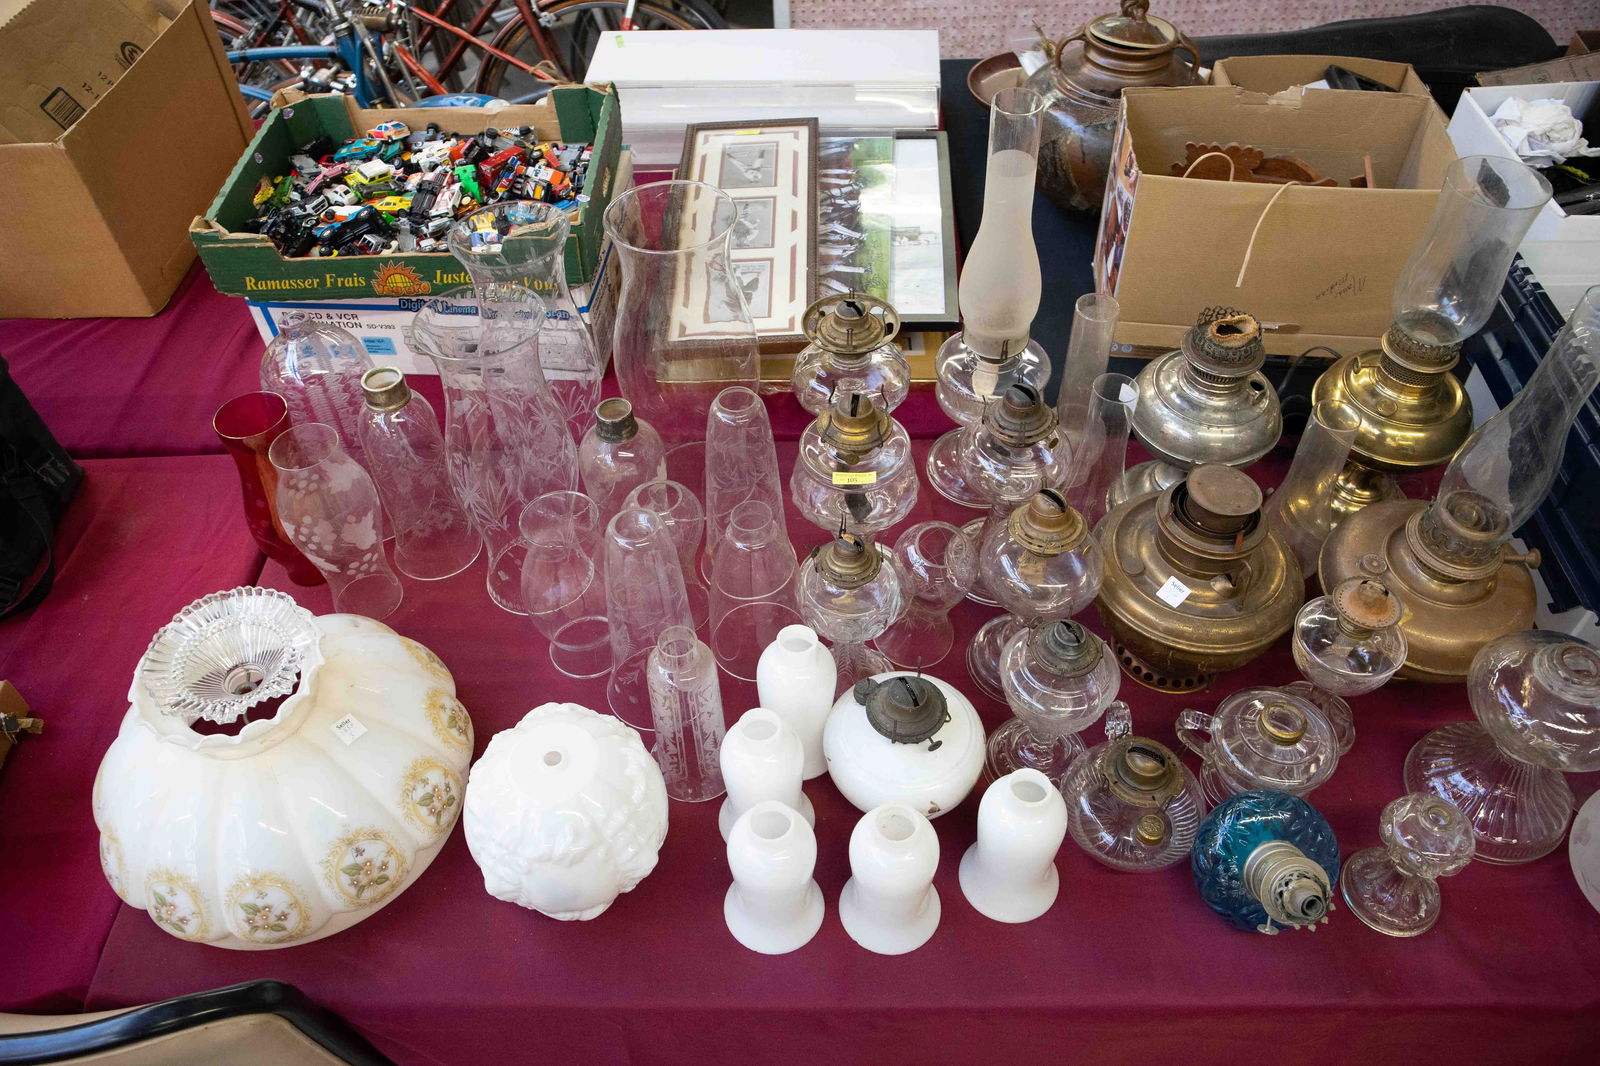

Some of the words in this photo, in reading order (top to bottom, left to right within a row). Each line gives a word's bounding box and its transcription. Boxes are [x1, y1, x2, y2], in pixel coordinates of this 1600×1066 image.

[244, 275, 320, 291] Ramasser
[325, 272, 366, 289] Frais
[433, 269, 472, 285] Juste
[336, 312, 360, 321] VCR
